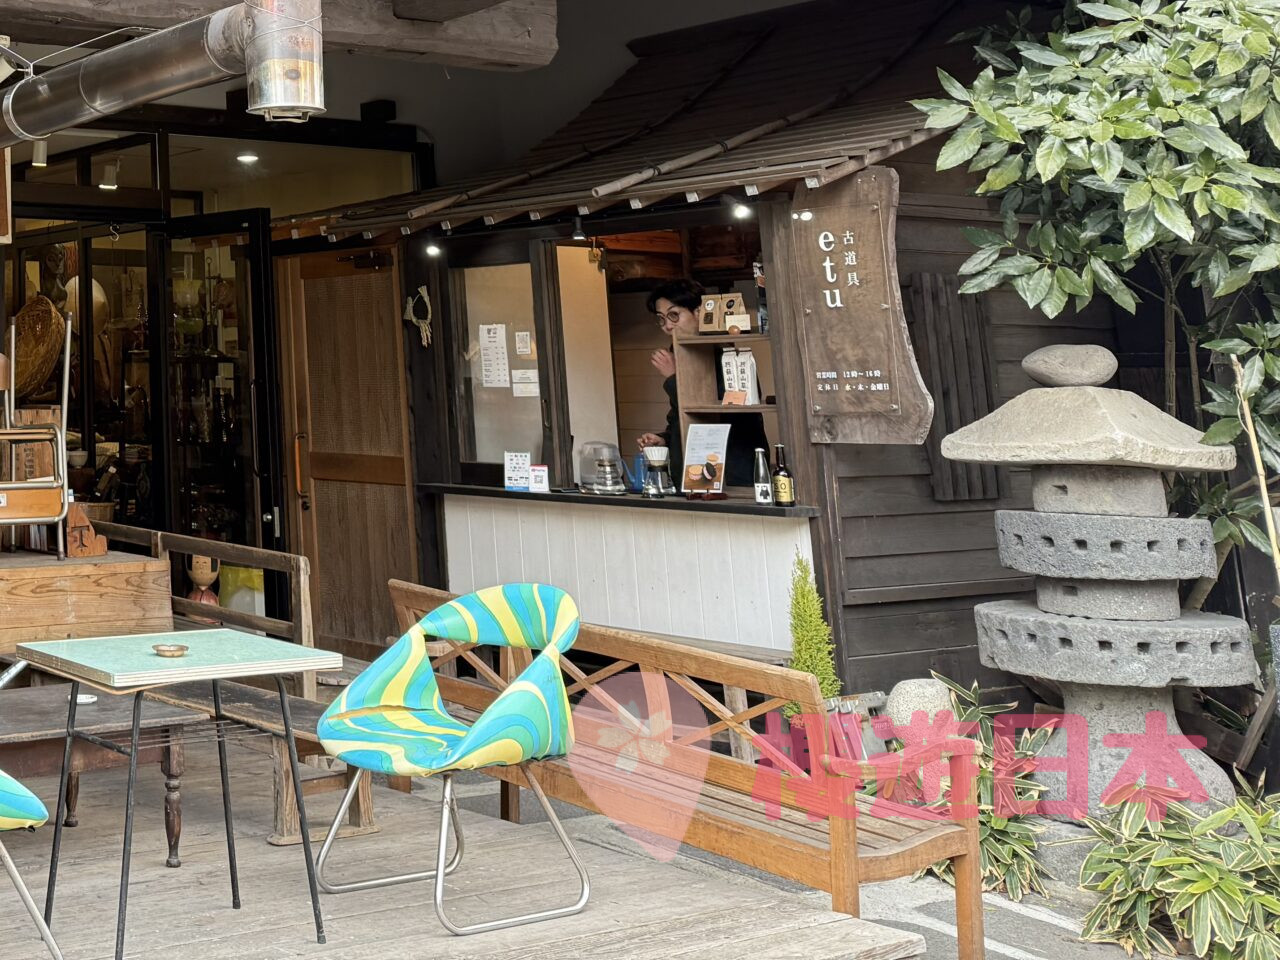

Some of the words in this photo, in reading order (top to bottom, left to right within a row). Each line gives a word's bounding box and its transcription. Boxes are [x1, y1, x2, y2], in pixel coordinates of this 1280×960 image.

[818, 231, 844, 308] etu
[841, 230, 860, 287] 古道具
[816, 383, 839, 391] 定休日
